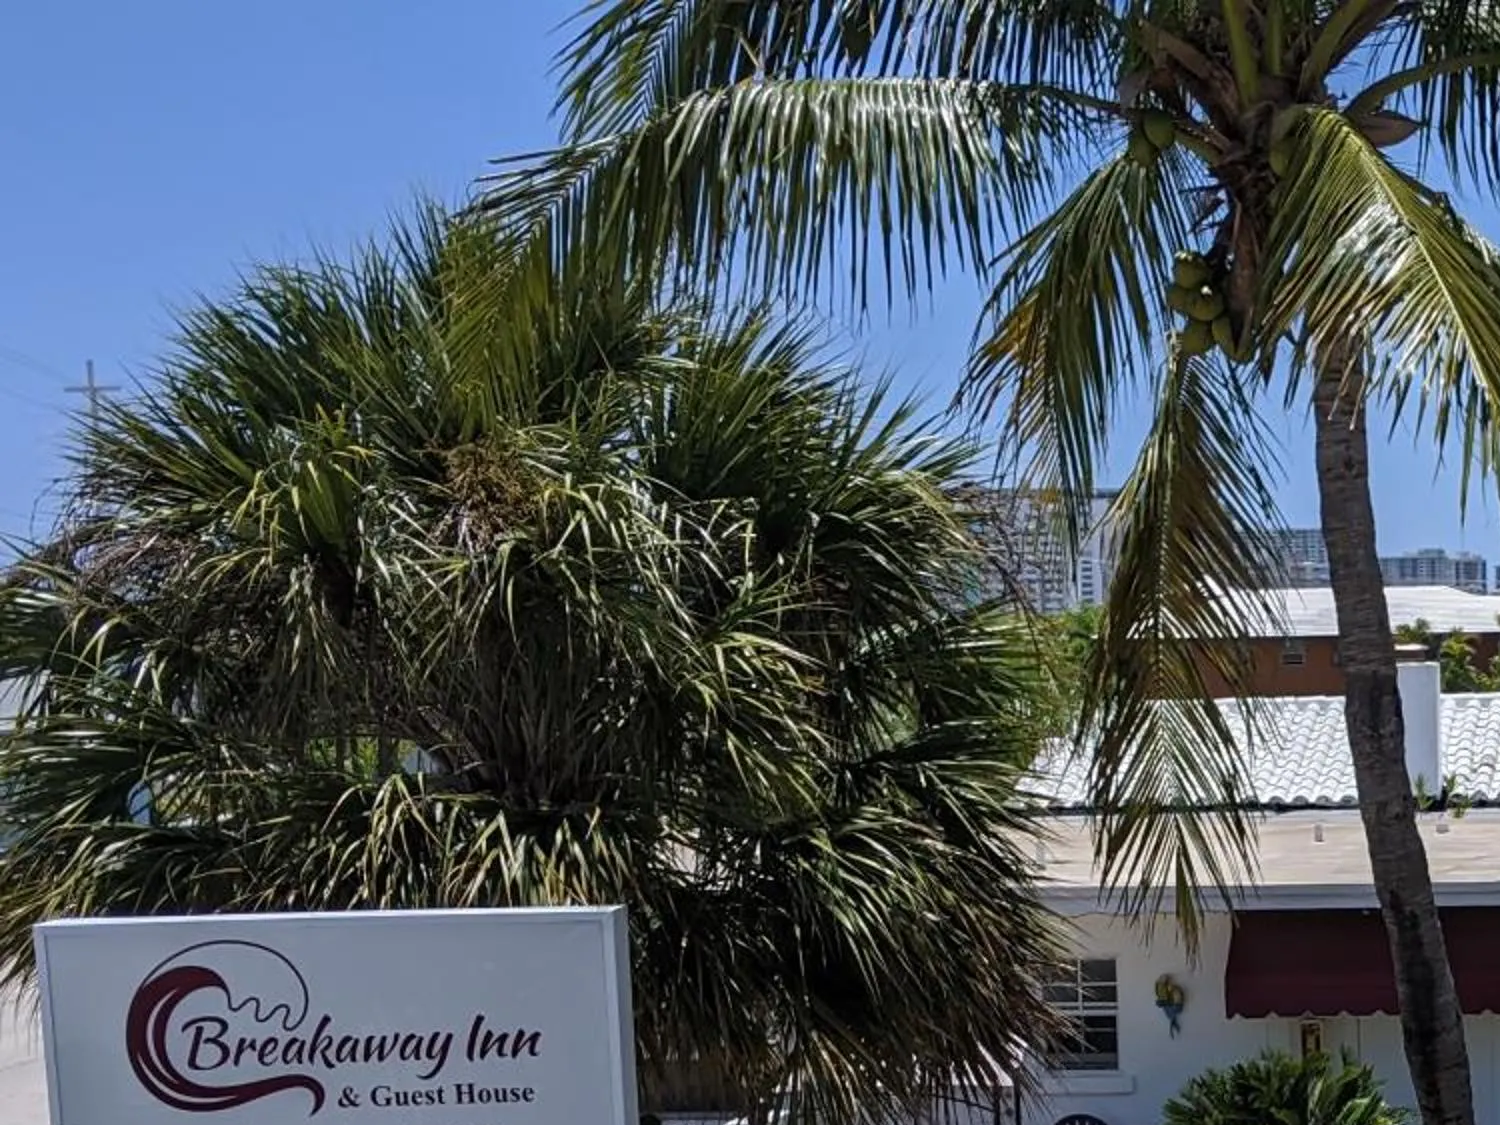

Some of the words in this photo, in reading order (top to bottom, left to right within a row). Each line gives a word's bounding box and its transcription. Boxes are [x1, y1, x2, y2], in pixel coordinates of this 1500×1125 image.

[181, 1014, 453, 1080] Breakaway
[466, 1014, 542, 1063] Inn
[337, 1086, 361, 1108] &
[369, 1084, 446, 1108] Guest
[453, 1082, 535, 1105] House
